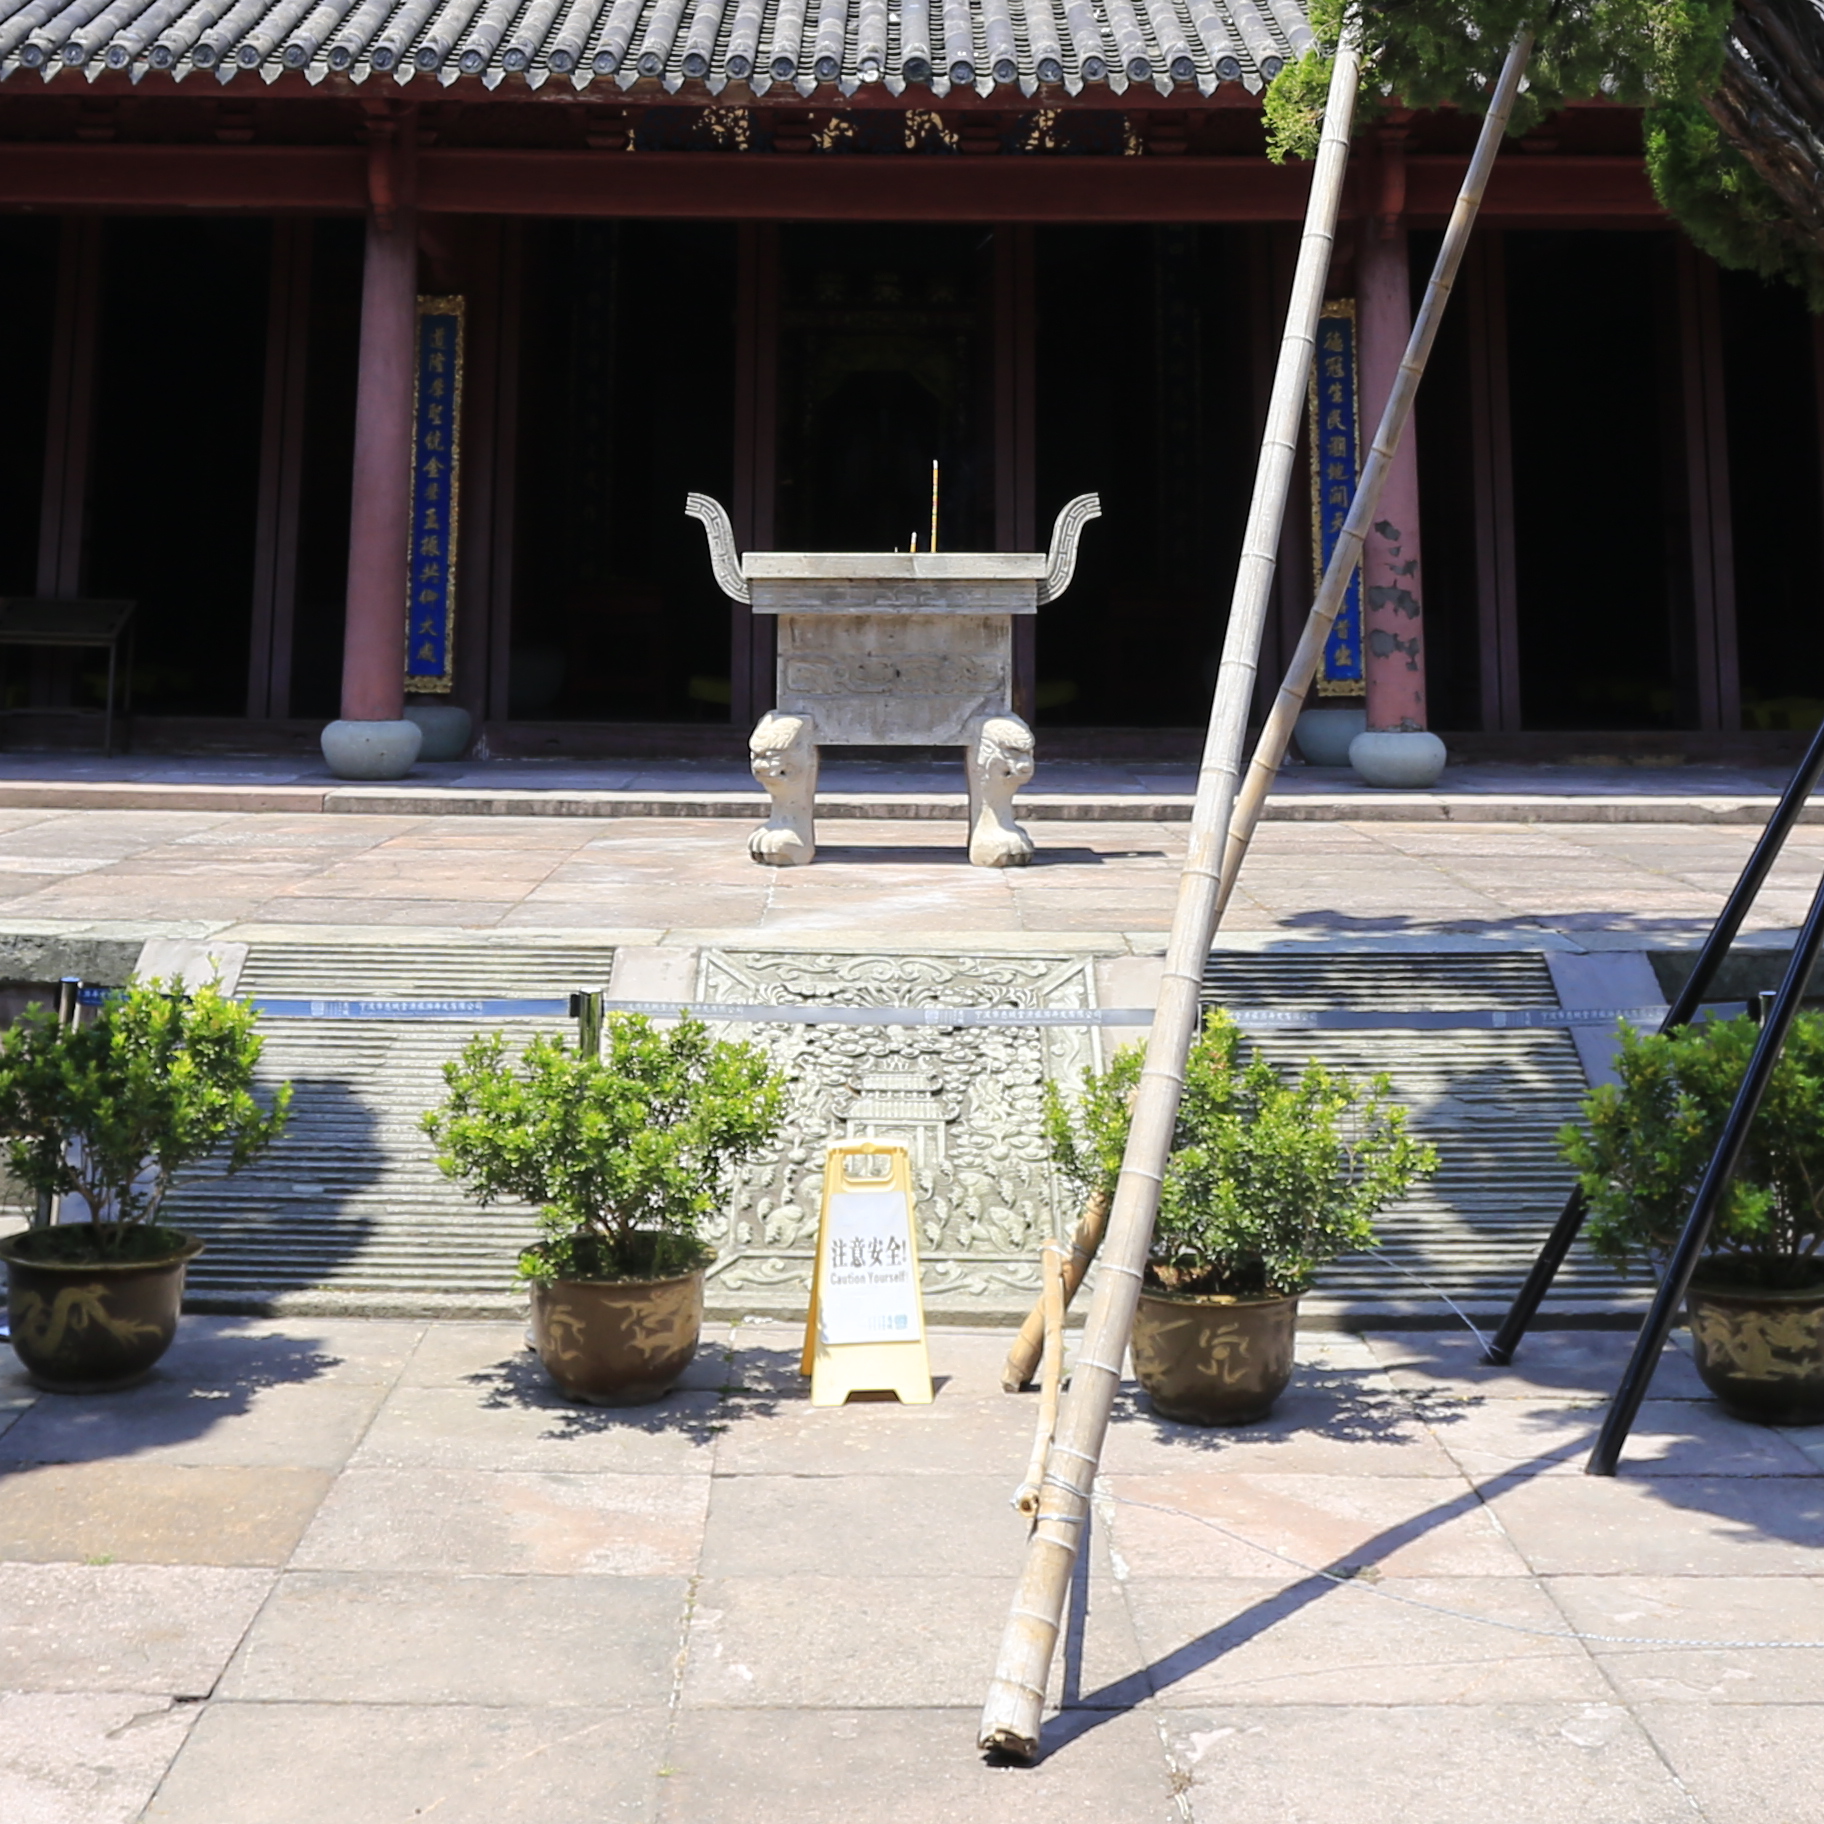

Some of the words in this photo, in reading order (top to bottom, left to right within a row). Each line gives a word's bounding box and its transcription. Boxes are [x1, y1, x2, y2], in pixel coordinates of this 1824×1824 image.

[831, 1235, 907, 1269] 注意安全!
[830, 1271, 866, 1285] Caution
